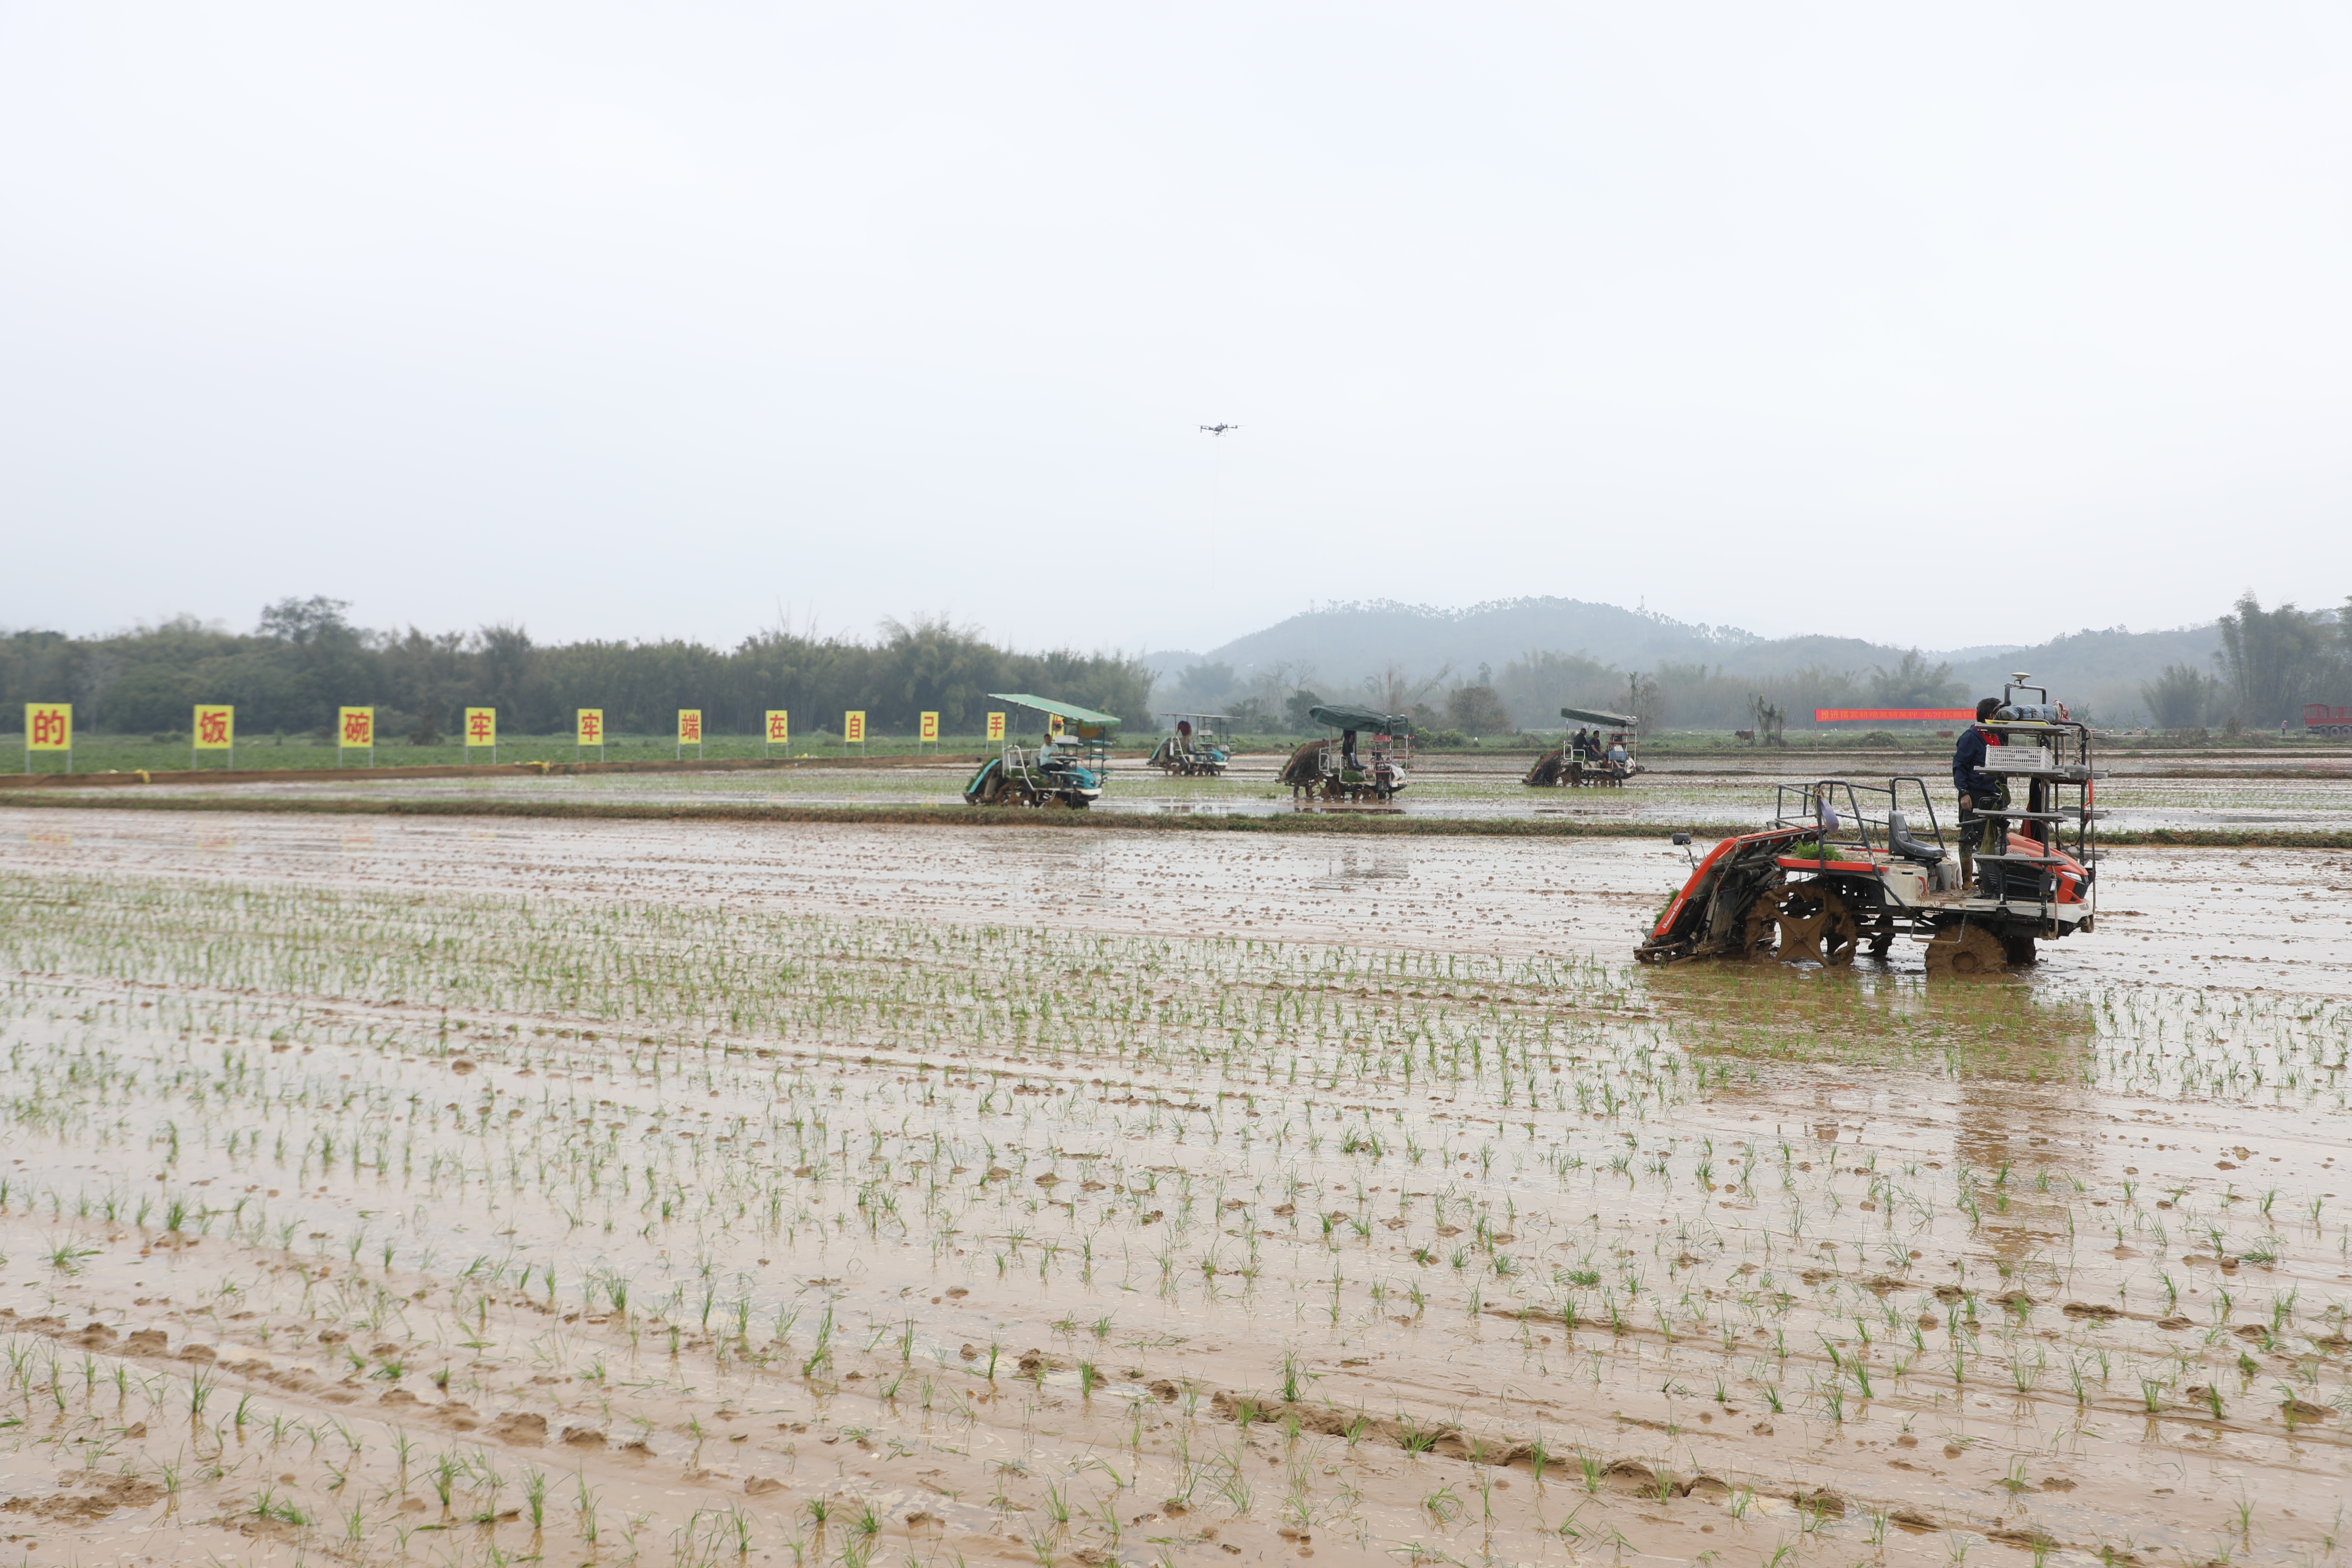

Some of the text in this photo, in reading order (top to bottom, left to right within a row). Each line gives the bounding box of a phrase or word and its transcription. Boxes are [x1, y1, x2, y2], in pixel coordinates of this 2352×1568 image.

[33, 710, 65, 745] 的
[199, 711, 228, 743] 饭
[344, 713, 370, 743] 碗
[470, 713, 492, 742] 牢
[581, 713, 599, 741] 牢
[681, 714, 699, 740] 端
[769, 715, 786, 739] 在
[849, 715, 861, 738] 自
[924, 716, 935, 736] 己
[990, 716, 1003, 737] 手
